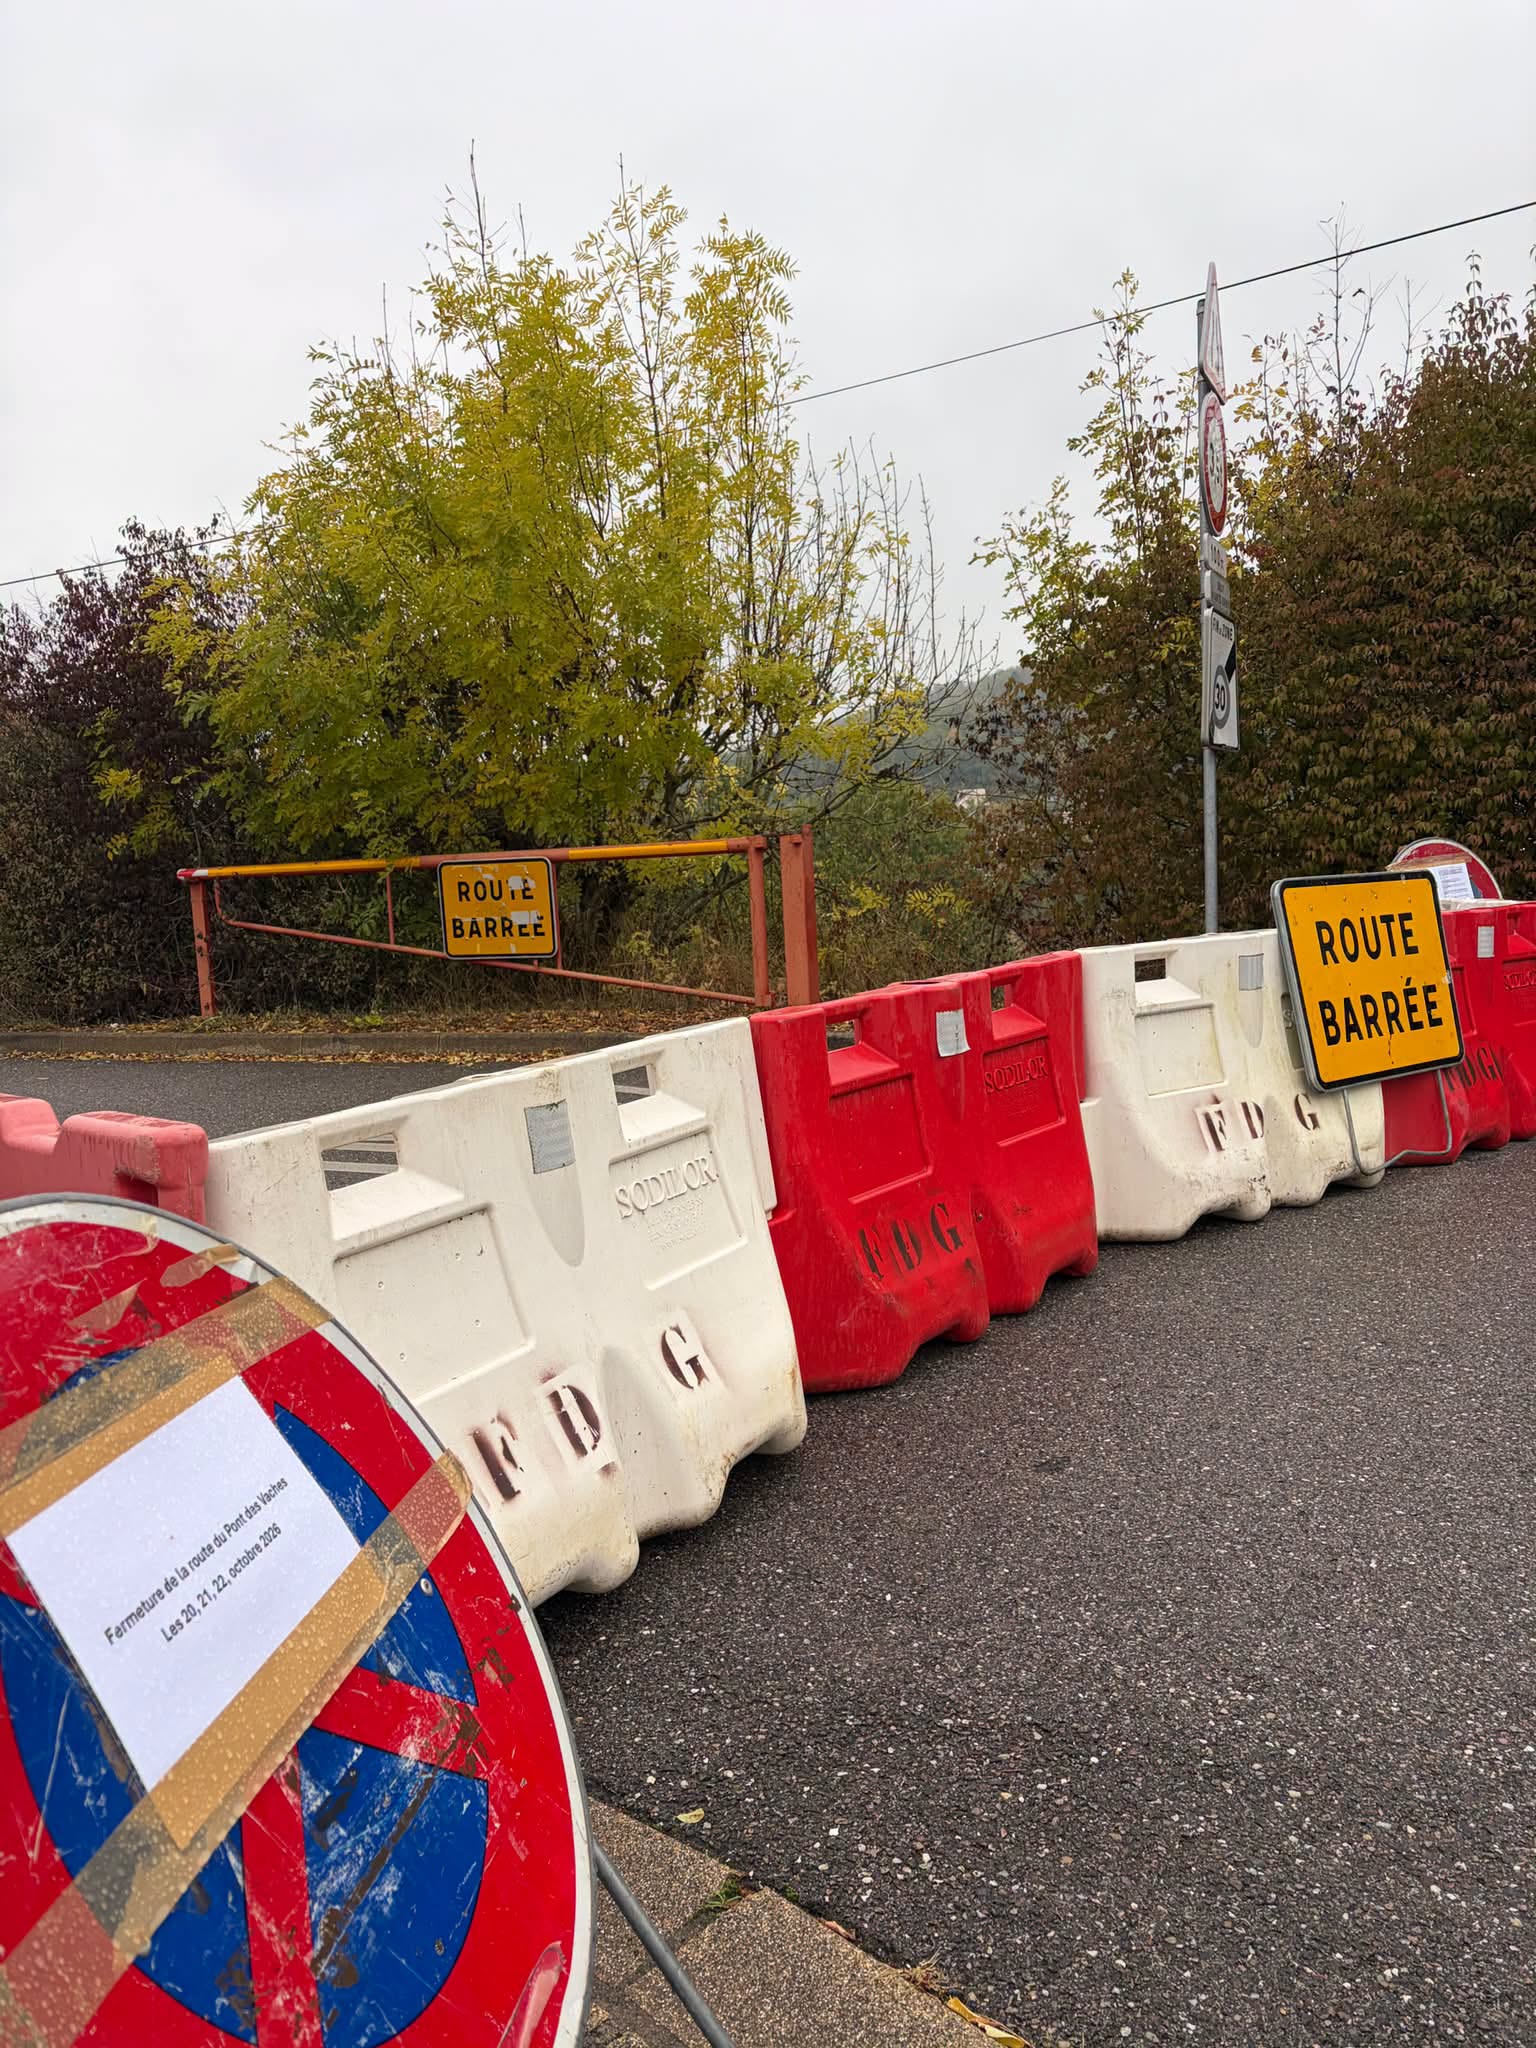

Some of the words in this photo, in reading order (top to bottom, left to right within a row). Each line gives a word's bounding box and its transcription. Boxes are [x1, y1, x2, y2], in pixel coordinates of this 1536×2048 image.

[1214, 682, 1226, 712] 30
[1315, 912, 1419, 966] ROUTE
[1318, 976, 1443, 1047] BARRÉE
[984, 1055, 1048, 1095] SODILOR
[615, 1156, 717, 1220] SODILOR
[103, 1587, 165, 1646] Fermeture
[163, 1576, 180, 1594] de
[174, 1566, 190, 1581] la
[187, 1546, 216, 1571] route
[213, 1533, 228, 1549] du
[223, 1512, 248, 1538] Pont
[244, 1501, 262, 1520] des
[256, 1477, 288, 1506] Vaches
[160, 1618, 185, 1643] Les
[180, 1603, 202, 1624] 20,
[196, 1588, 217, 1608] 21,
[211, 1574, 232, 1593] 22,
[228, 1541, 263, 1579] octobre
[258, 1522, 282, 1548] 2026
